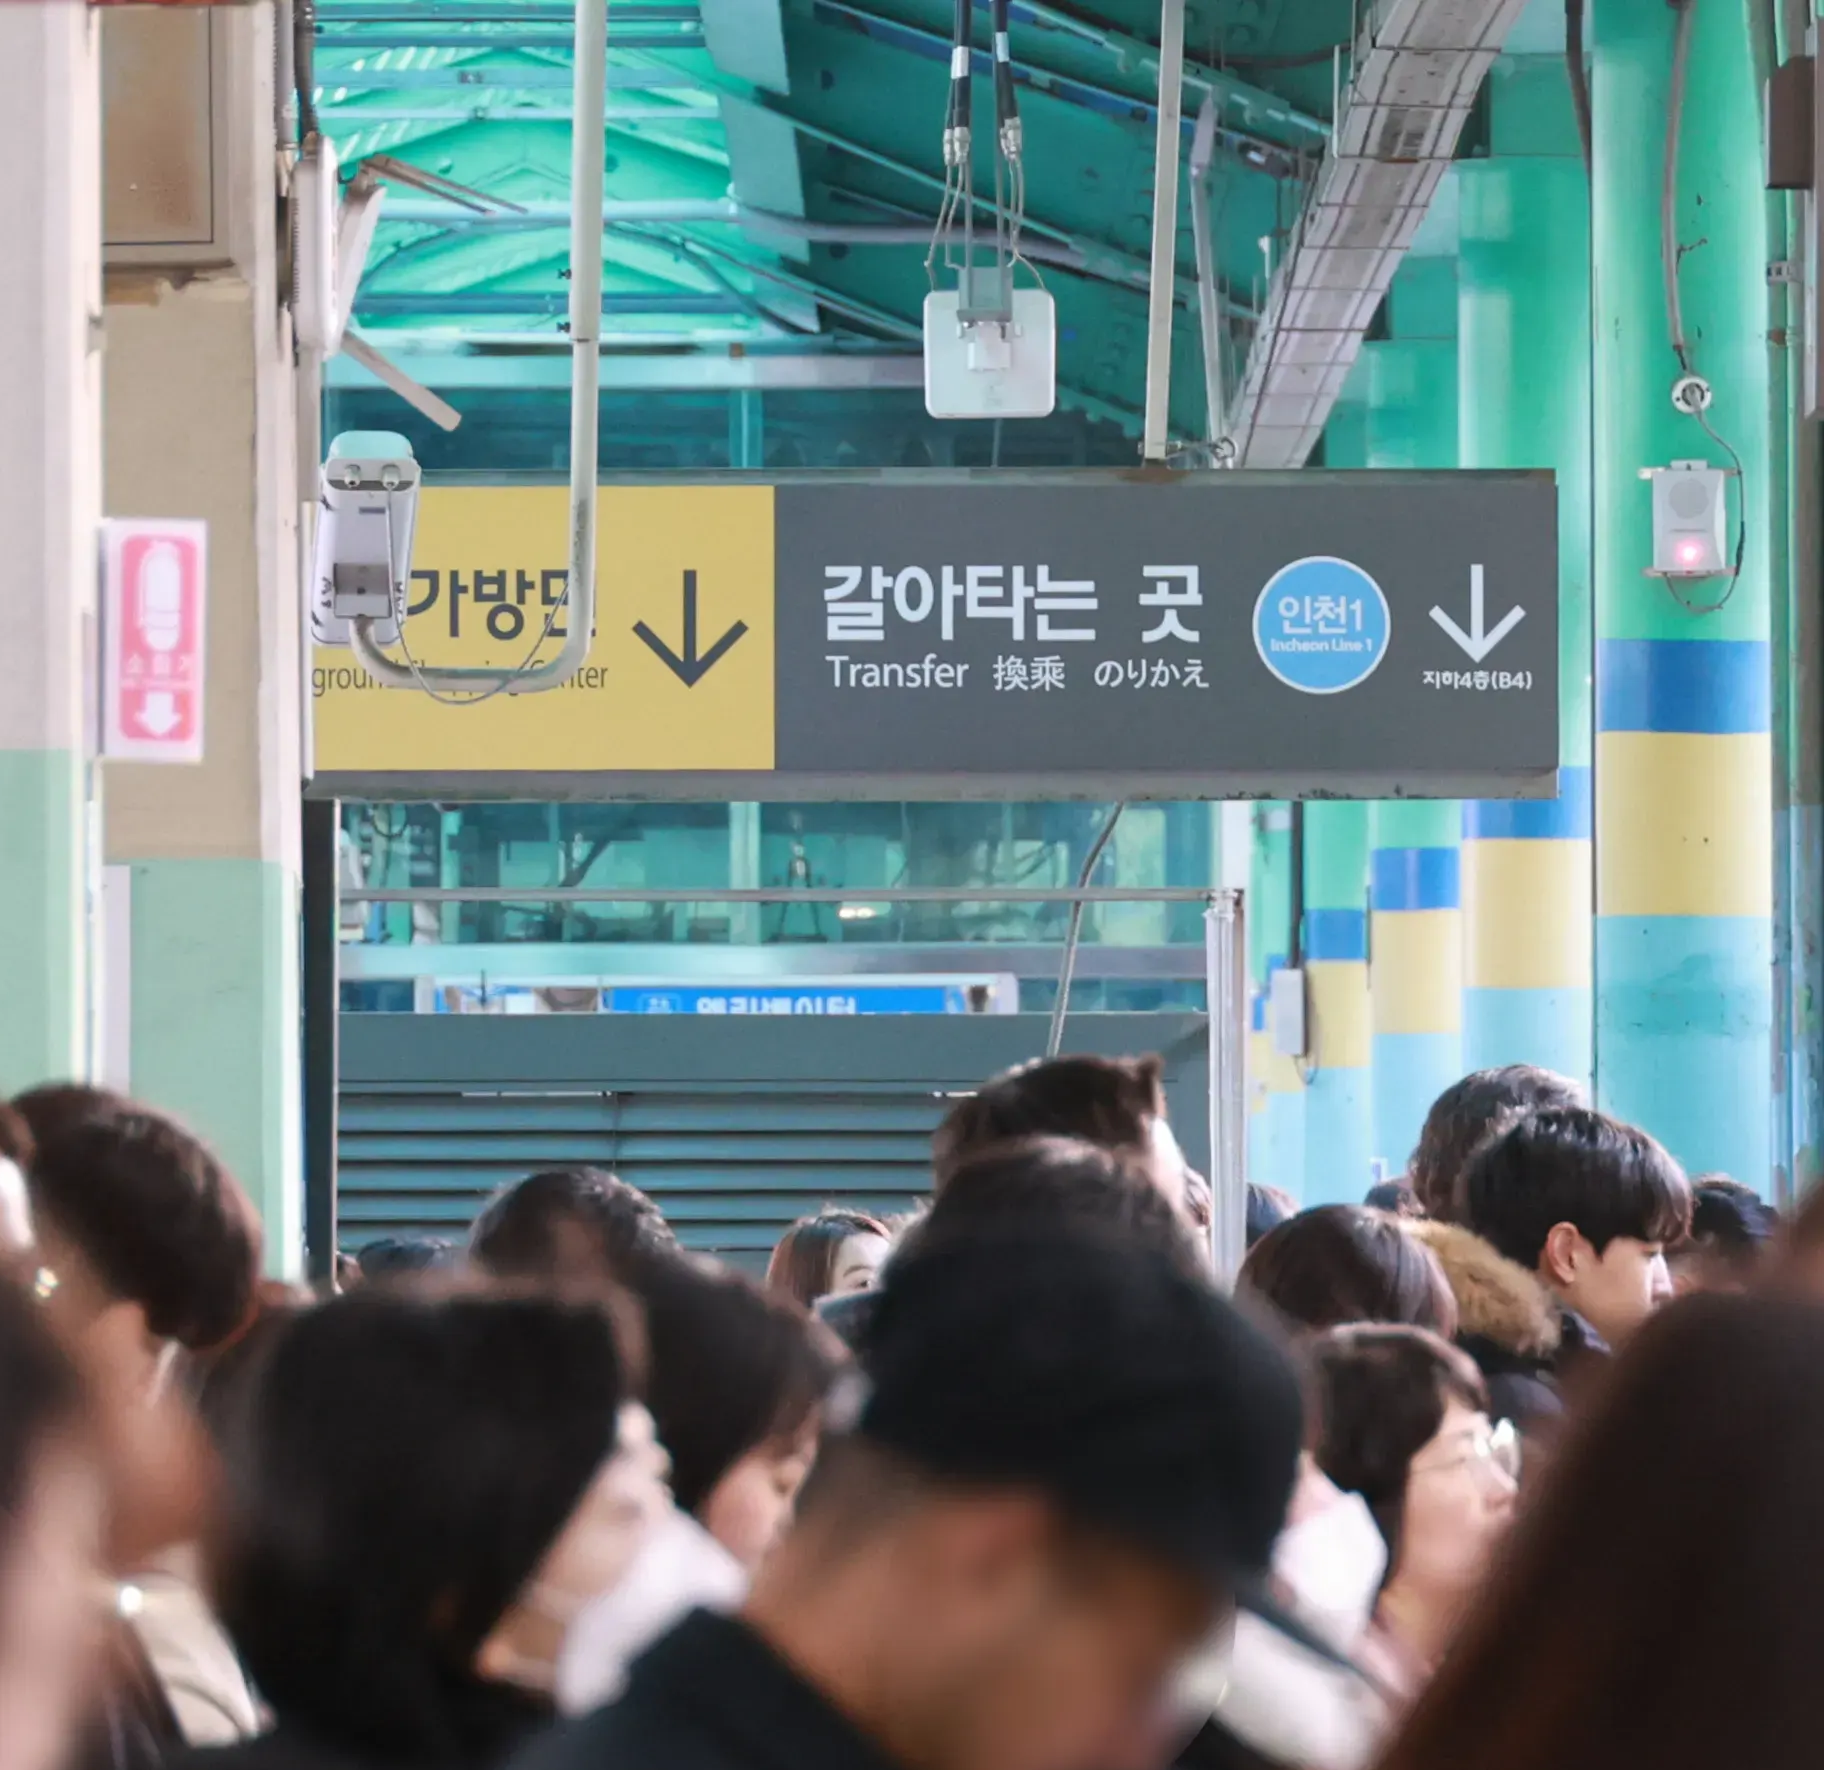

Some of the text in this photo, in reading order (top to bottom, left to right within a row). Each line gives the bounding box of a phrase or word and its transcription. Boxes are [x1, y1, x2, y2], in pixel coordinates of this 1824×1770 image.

[824, 564, 1204, 643] 갈아타는 곳
[1278, 595, 1363, 635] 인천1
[1270, 638, 1330, 652] Incheon
[1332, 638, 1363, 652] Line
[825, 653, 970, 689] Transfer
[1093, 658, 1210, 690] のりかえ
[1422, 670, 1533, 691] 지하4층(B4)
